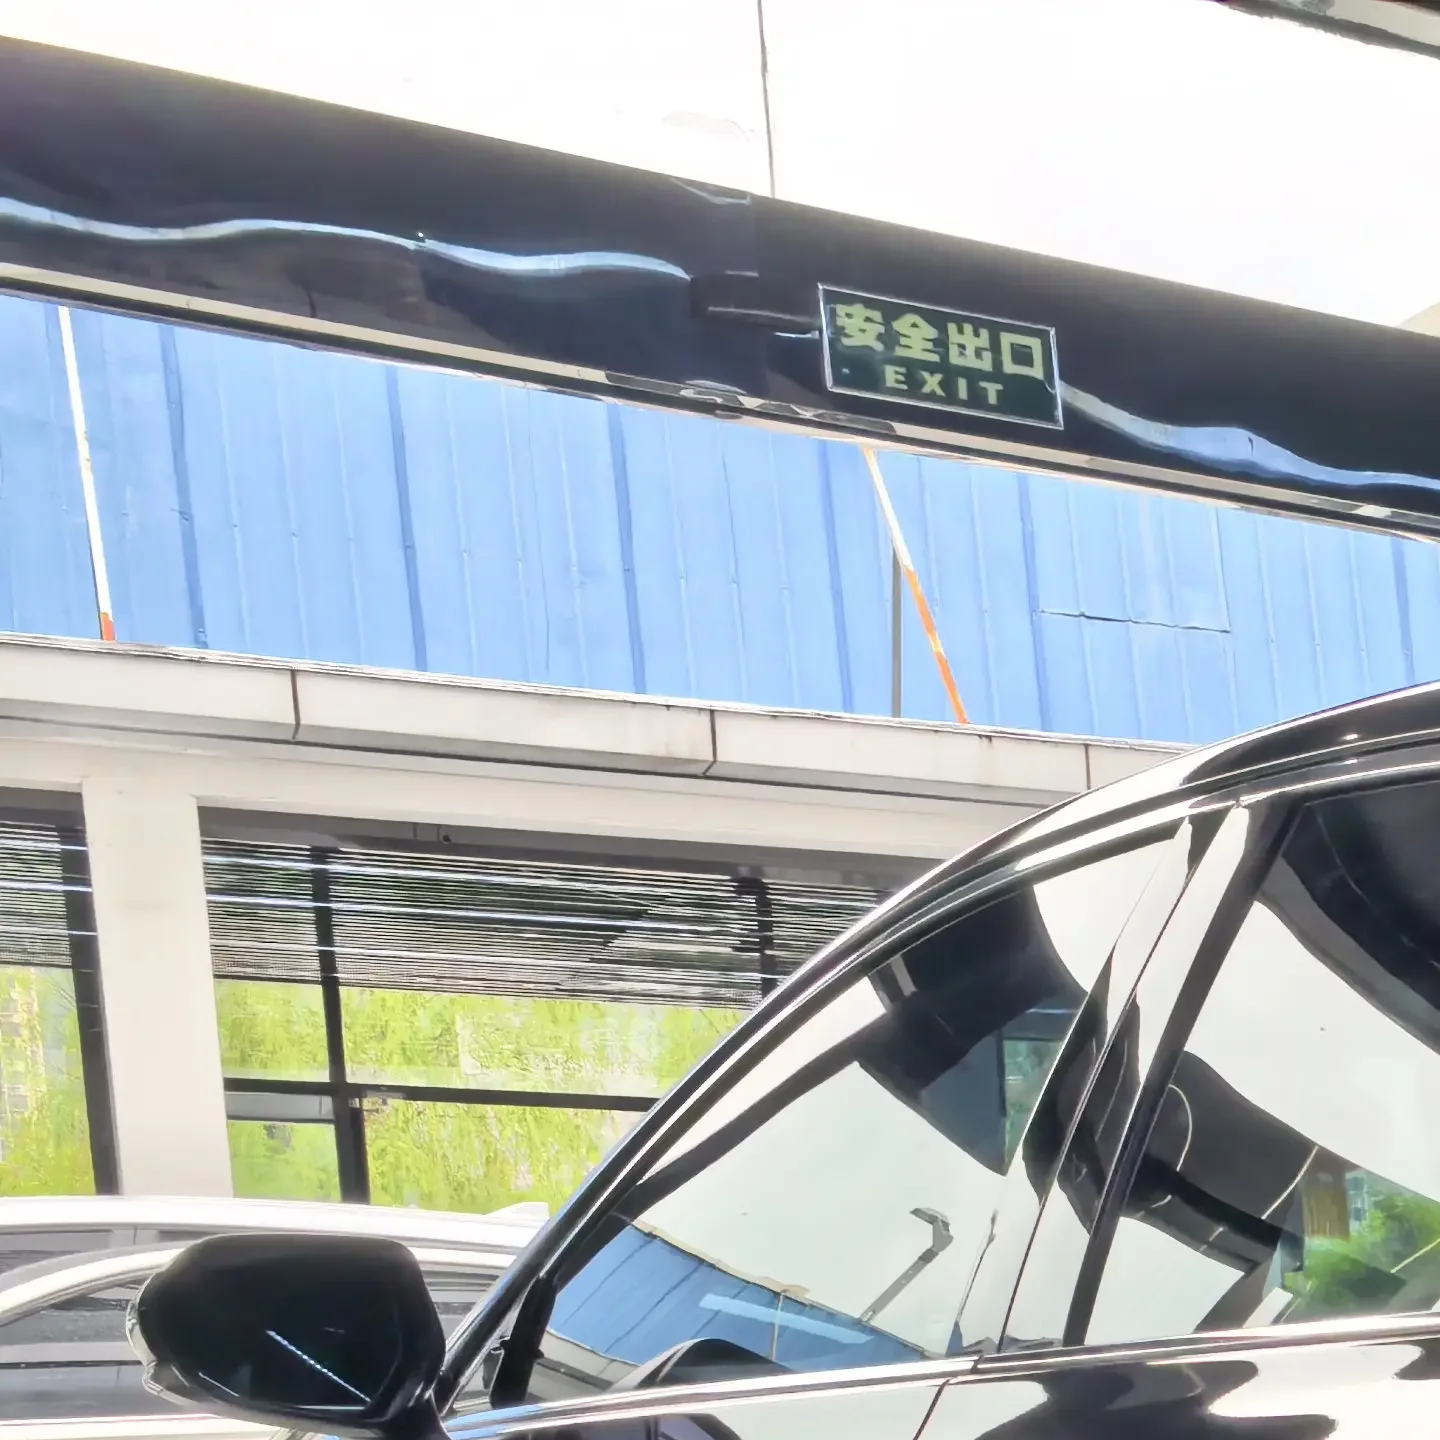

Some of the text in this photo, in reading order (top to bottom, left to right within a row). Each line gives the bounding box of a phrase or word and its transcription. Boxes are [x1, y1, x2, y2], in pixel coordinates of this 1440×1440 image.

[834, 302, 1045, 381] 安全出口
[883, 363, 1005, 406] EXIT
